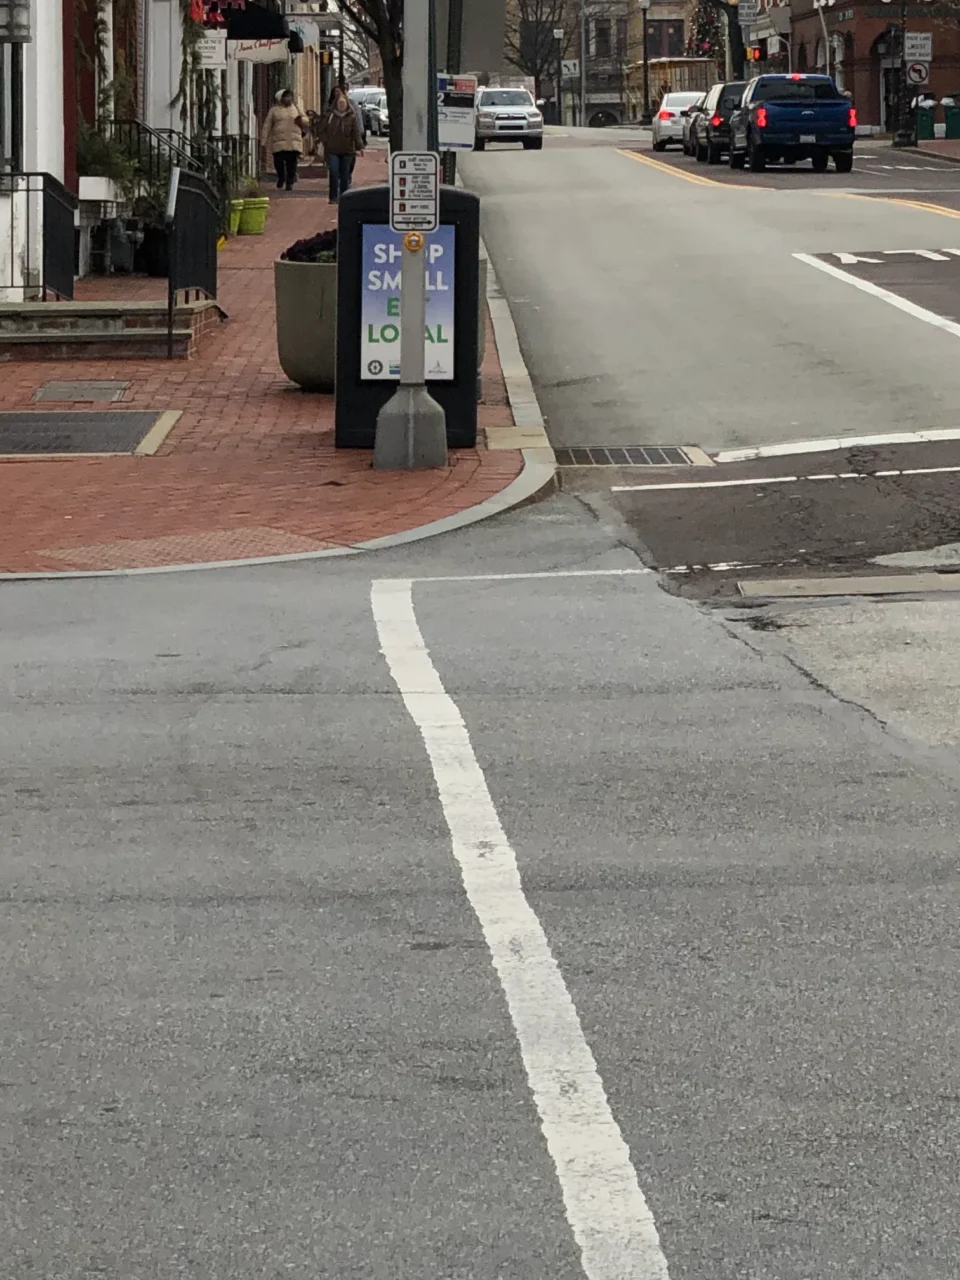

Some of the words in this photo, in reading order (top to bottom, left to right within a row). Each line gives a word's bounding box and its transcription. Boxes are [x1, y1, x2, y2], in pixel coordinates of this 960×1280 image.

[374, 243, 444, 264] SHP
[367, 270, 449, 291] SMLL
[368, 324, 449, 344] LOAL
